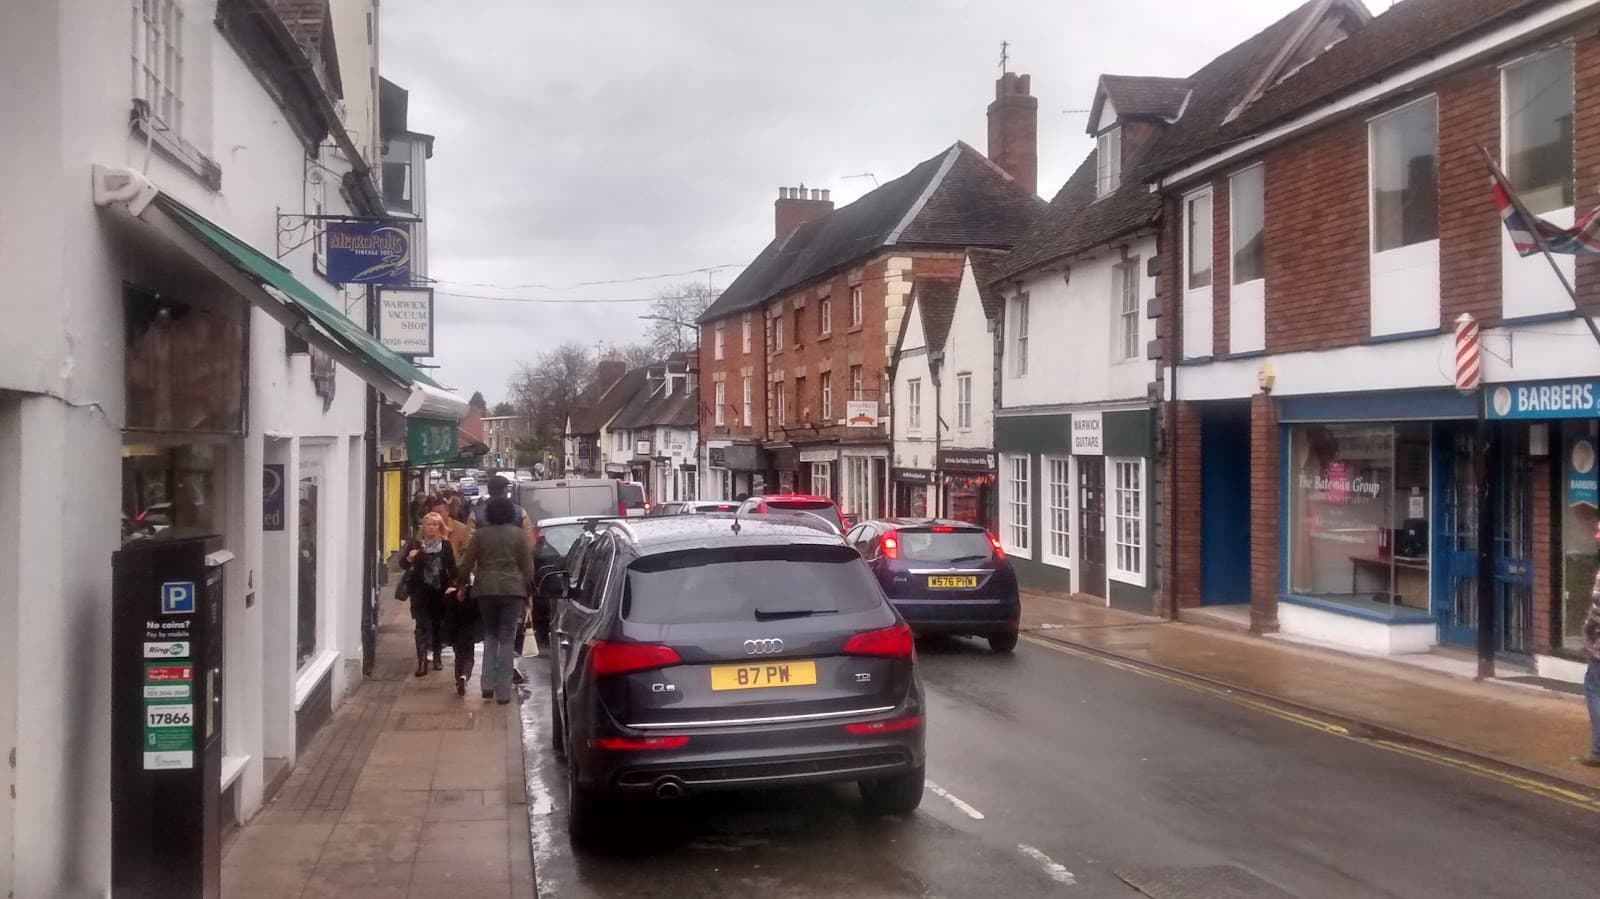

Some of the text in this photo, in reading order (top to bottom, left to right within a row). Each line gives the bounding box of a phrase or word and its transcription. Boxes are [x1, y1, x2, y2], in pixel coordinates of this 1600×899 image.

[383, 300, 427, 309] WARWICK
[388, 310, 427, 320] VACUUM
[400, 320, 428, 330] SHOP
[1517, 384, 1594, 411] BARBERS
[1074, 419, 1101, 430] WARWICK
[1075, 436, 1099, 448] GUITARS
[1314, 475, 1351, 492] Bateman
[1352, 476, 1380, 499] Group
[1570, 479, 1598, 490] BARBERS
[169, 586, 187, 609] P
[146, 620, 190, 630] No coins?
[146, 631, 158, 639] Pay
[158, 631, 167, 639] by
[737, 665, 790, 686] 87 PW
[149, 713, 190, 725] 17866
